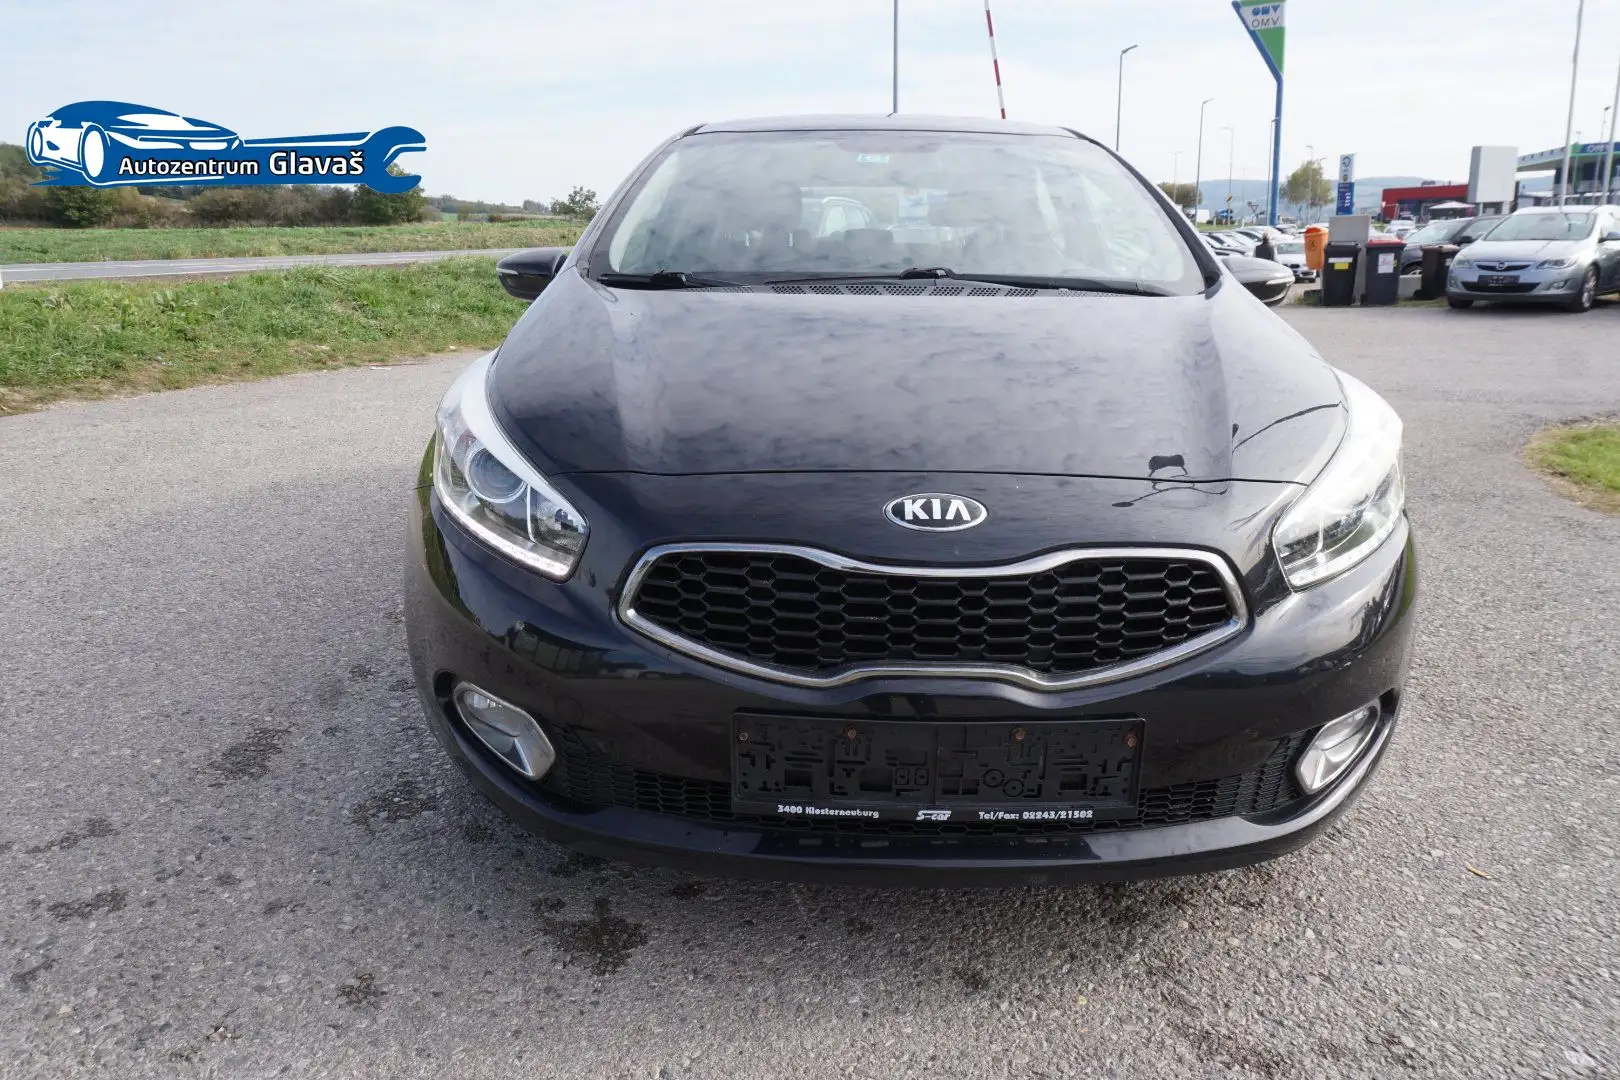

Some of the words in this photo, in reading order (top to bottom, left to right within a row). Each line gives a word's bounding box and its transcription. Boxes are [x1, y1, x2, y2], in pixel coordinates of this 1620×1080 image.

[1251, 16, 1280, 28] OMV
[902, 498, 972, 521] KIA
[777, 804, 803, 814] 3400
[805, 806, 880, 819] Klosterneuburg
[978, 811, 1020, 821] Tel/Fax:
